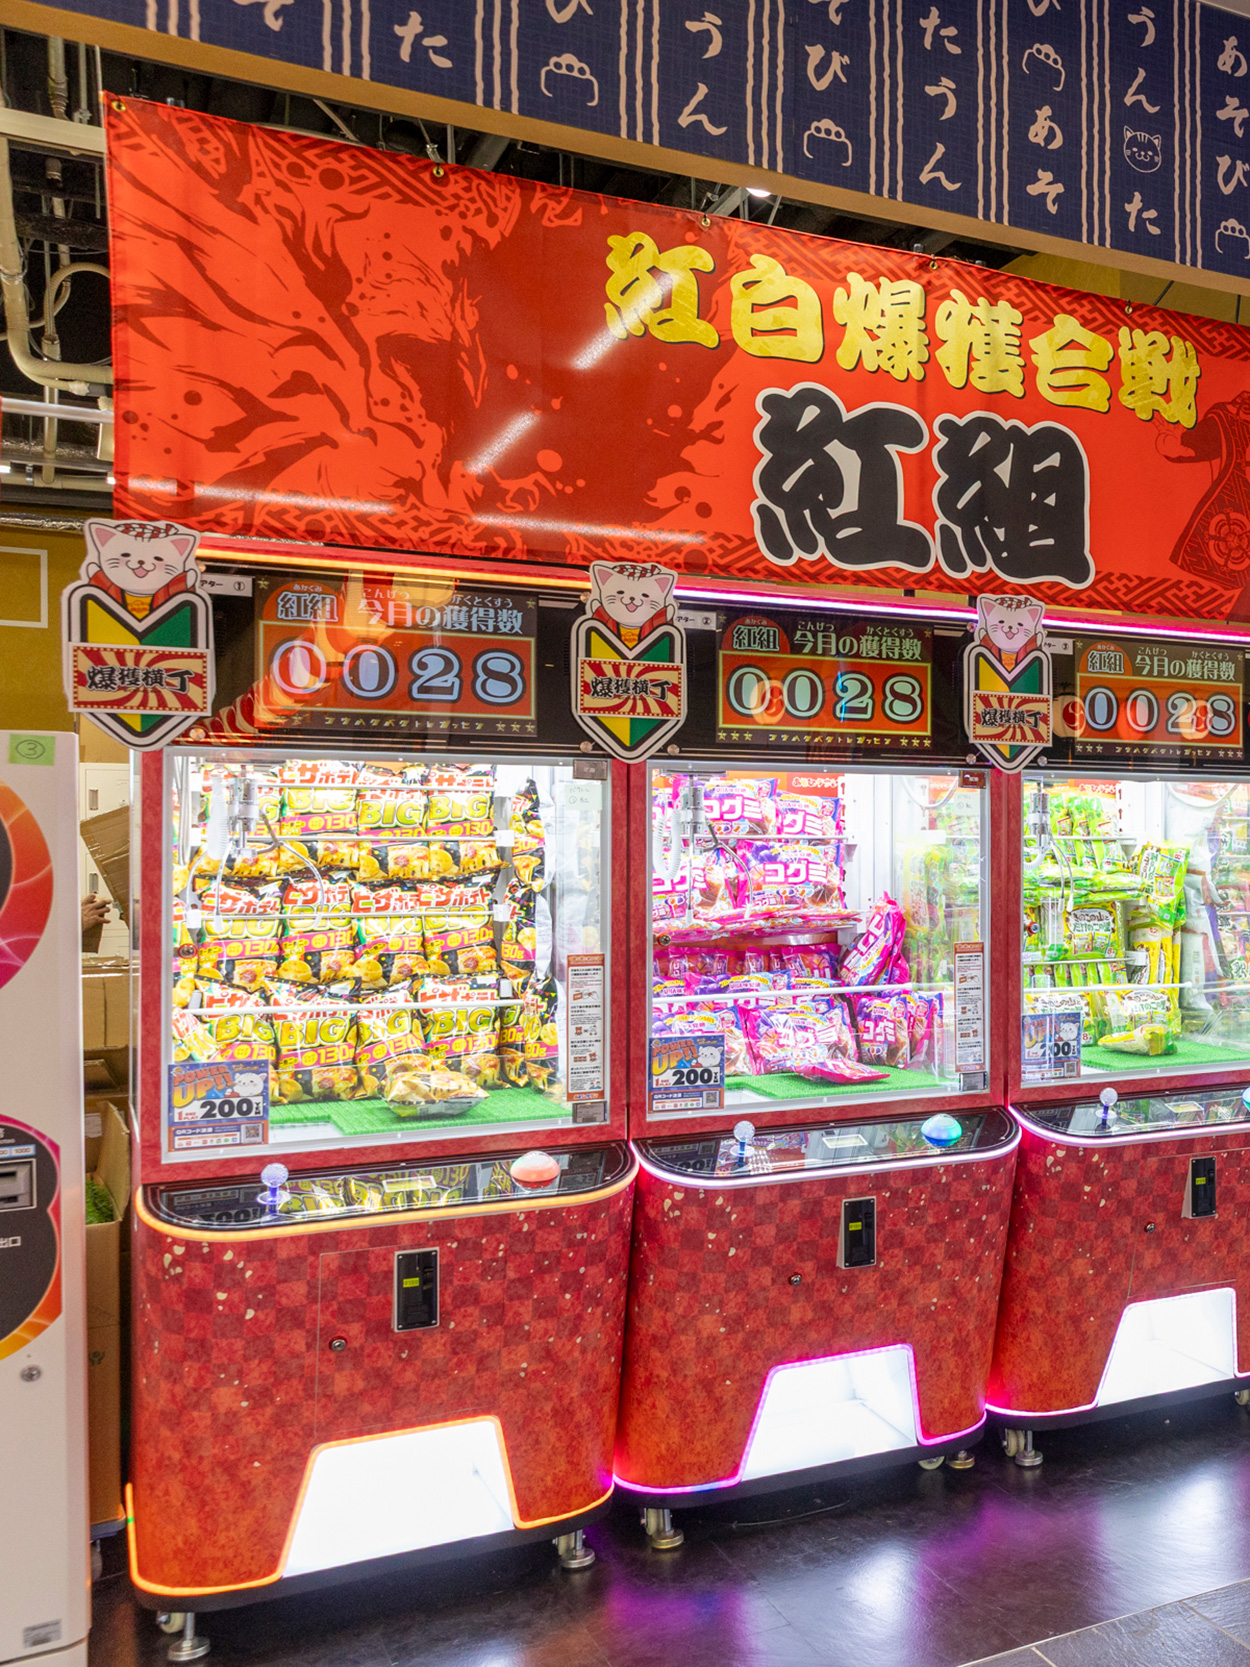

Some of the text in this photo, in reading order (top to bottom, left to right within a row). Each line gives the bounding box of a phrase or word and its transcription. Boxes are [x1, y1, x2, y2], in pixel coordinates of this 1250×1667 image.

[394, 11, 453, 68] た
[919, 6, 962, 191] たうん
[1215, 35, 1250, 195] あそび
[1026, 105, 1065, 215] あそ
[604, 230, 1202, 430] 紅白爆獲合戦
[750, 380, 1097, 590] 紅組
[276, 591, 339, 623] 紅組
[356, 598, 525, 636] 今月の獲得数
[731, 624, 781, 653] 紅組
[793, 629, 923, 662] 今月の獲得数
[271, 639, 527, 707] 0028
[1086, 648, 1125, 675] 紅組
[1134, 652, 1237, 682] 今月の獲得数
[86, 665, 196, 695] 爆獲横丁
[590, 676, 673, 702] 爆獲横丁
[725, 663, 926, 725] 0028
[979, 706, 1044, 730] 爆獲横丁
[1083, 684, 1238, 738] 0028
[286, 788, 357, 813] BIG
[428, 794, 489, 821] BIG
[703, 794, 764, 822] コグミ
[763, 858, 828, 885] コグミ
[215, 1012, 276, 1043] BIG
[279, 1014, 350, 1047] BIG
[431, 1006, 494, 1036] BIG
[652, 1039, 695, 1056] POWER
[1039, 1042, 1072, 1058] 200
[173, 1065, 230, 1087] POWER
[672, 1068, 713, 1087] 200
[200, 1098, 254, 1120] 200
